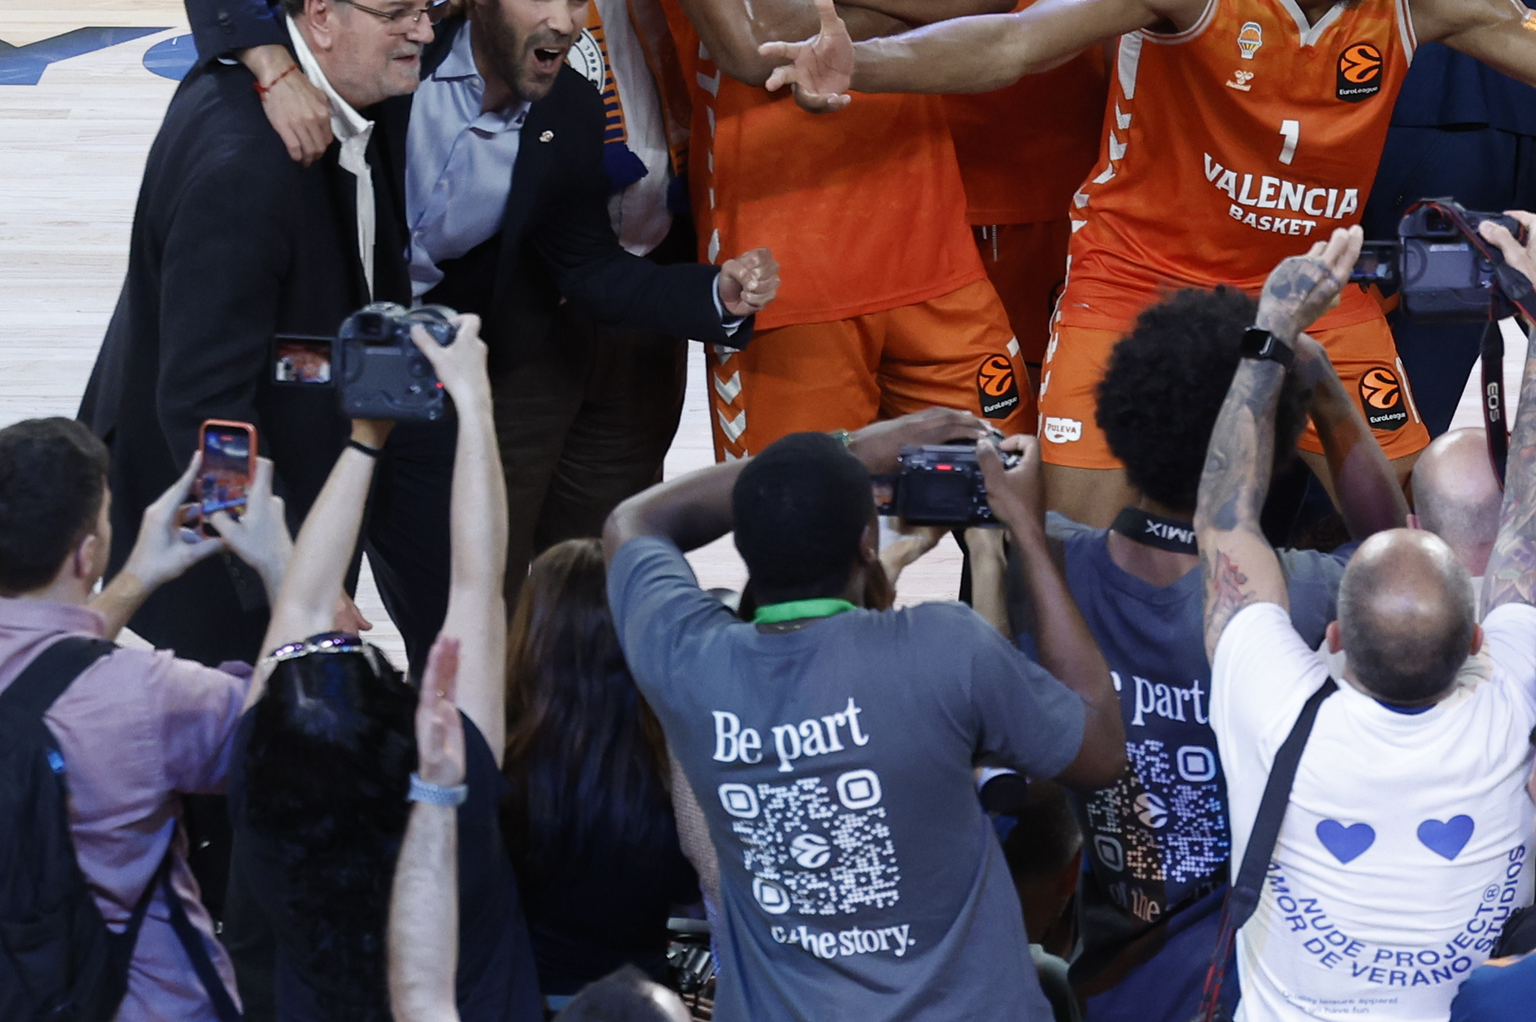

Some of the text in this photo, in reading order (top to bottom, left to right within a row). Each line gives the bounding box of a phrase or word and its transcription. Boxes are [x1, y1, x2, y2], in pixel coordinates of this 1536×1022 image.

[1339, 85, 1378, 96] EuroLeague
[1279, 120, 1299, 165] 1
[1203, 152, 1360, 220] VALENCIA
[1228, 204, 1316, 236] BASKET
[984, 396, 1019, 413] EuroLeague
[1370, 412, 1406, 424] EuroLeague
[1486, 381, 1500, 422] EOS
[1047, 423, 1077, 434] PULEVA
[1131, 675, 1209, 726] part
[712, 697, 869, 772] Be part
[1298, 897, 1366, 958] NUDE
[1302, 937, 1343, 970] DE
[1350, 955, 1473, 987] VERANO
[1474, 844, 1526, 954] STUDIOS
